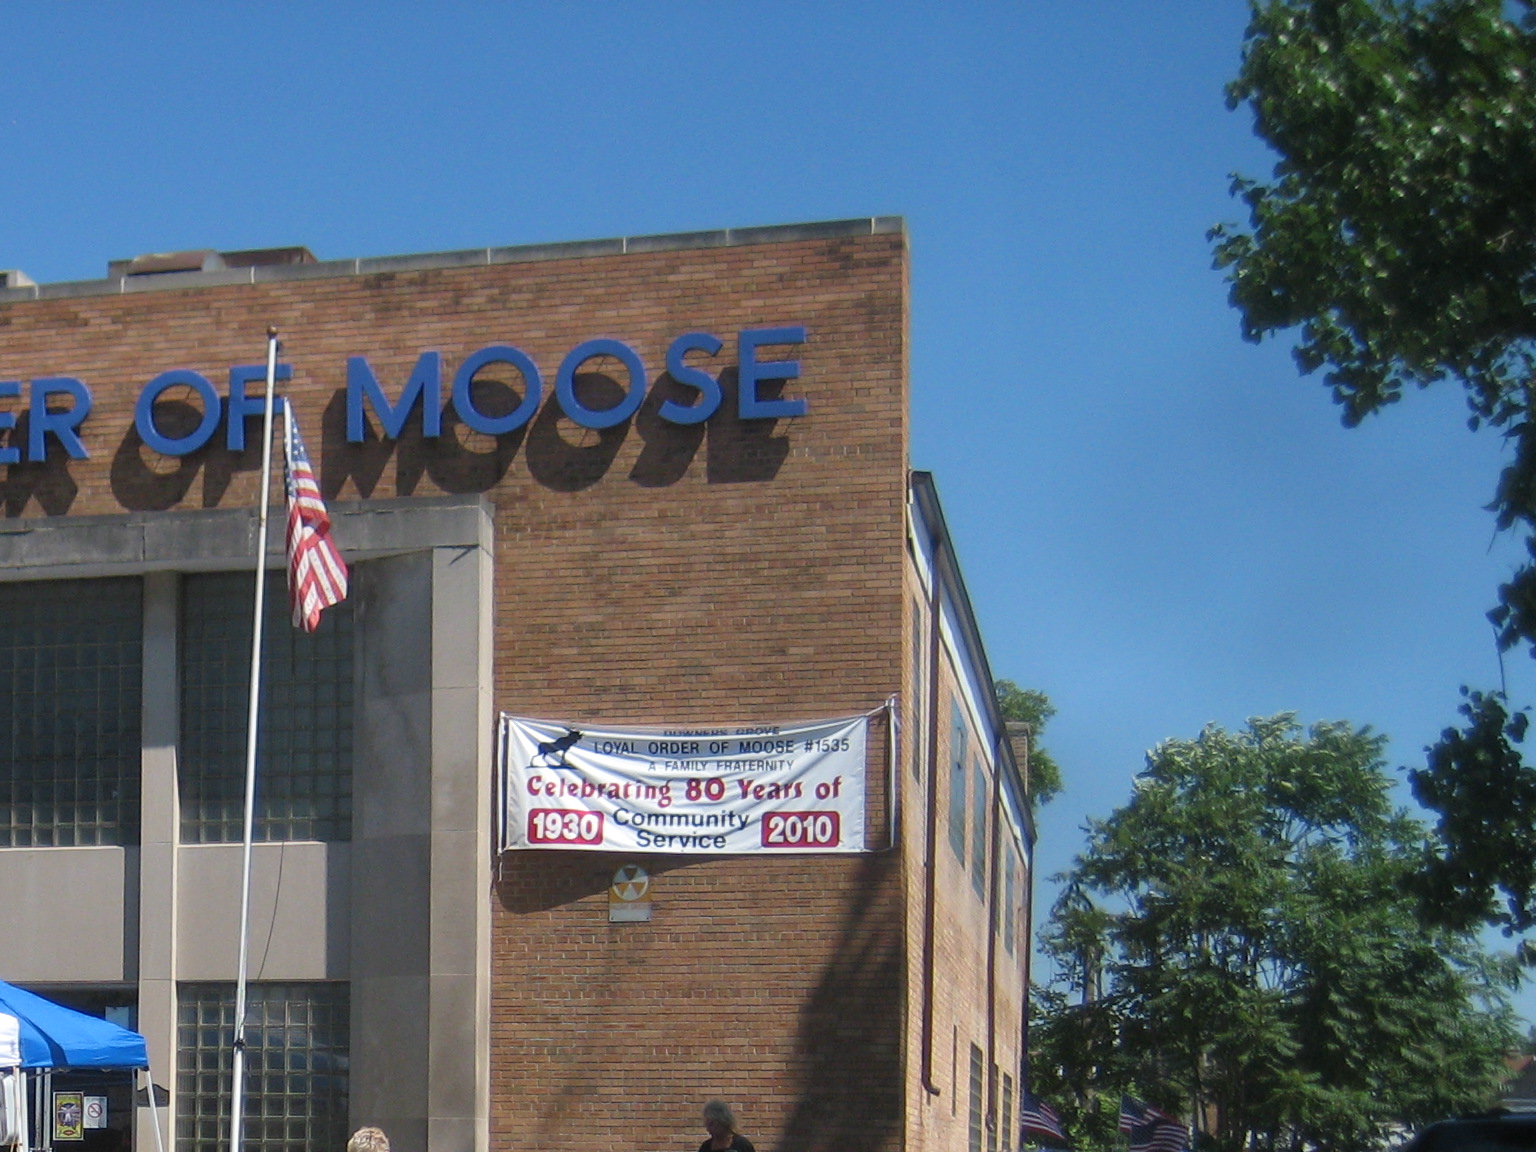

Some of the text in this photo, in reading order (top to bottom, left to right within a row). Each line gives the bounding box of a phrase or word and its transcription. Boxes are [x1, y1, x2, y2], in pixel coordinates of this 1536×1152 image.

[134, 363, 293, 456] OF
[346, 326, 808, 444] MOOSE
[594, 738, 851, 755] LOYAL ORDER OF MOOSE #1535
[648, 759, 796, 772] A FAMILY FRATERNITY
[526, 775, 844, 808] Celebrating 80 Years of
[533, 811, 600, 842] 1930
[613, 807, 751, 829] Community
[767, 815, 833, 844] 2010
[636, 829, 728, 849] Service
